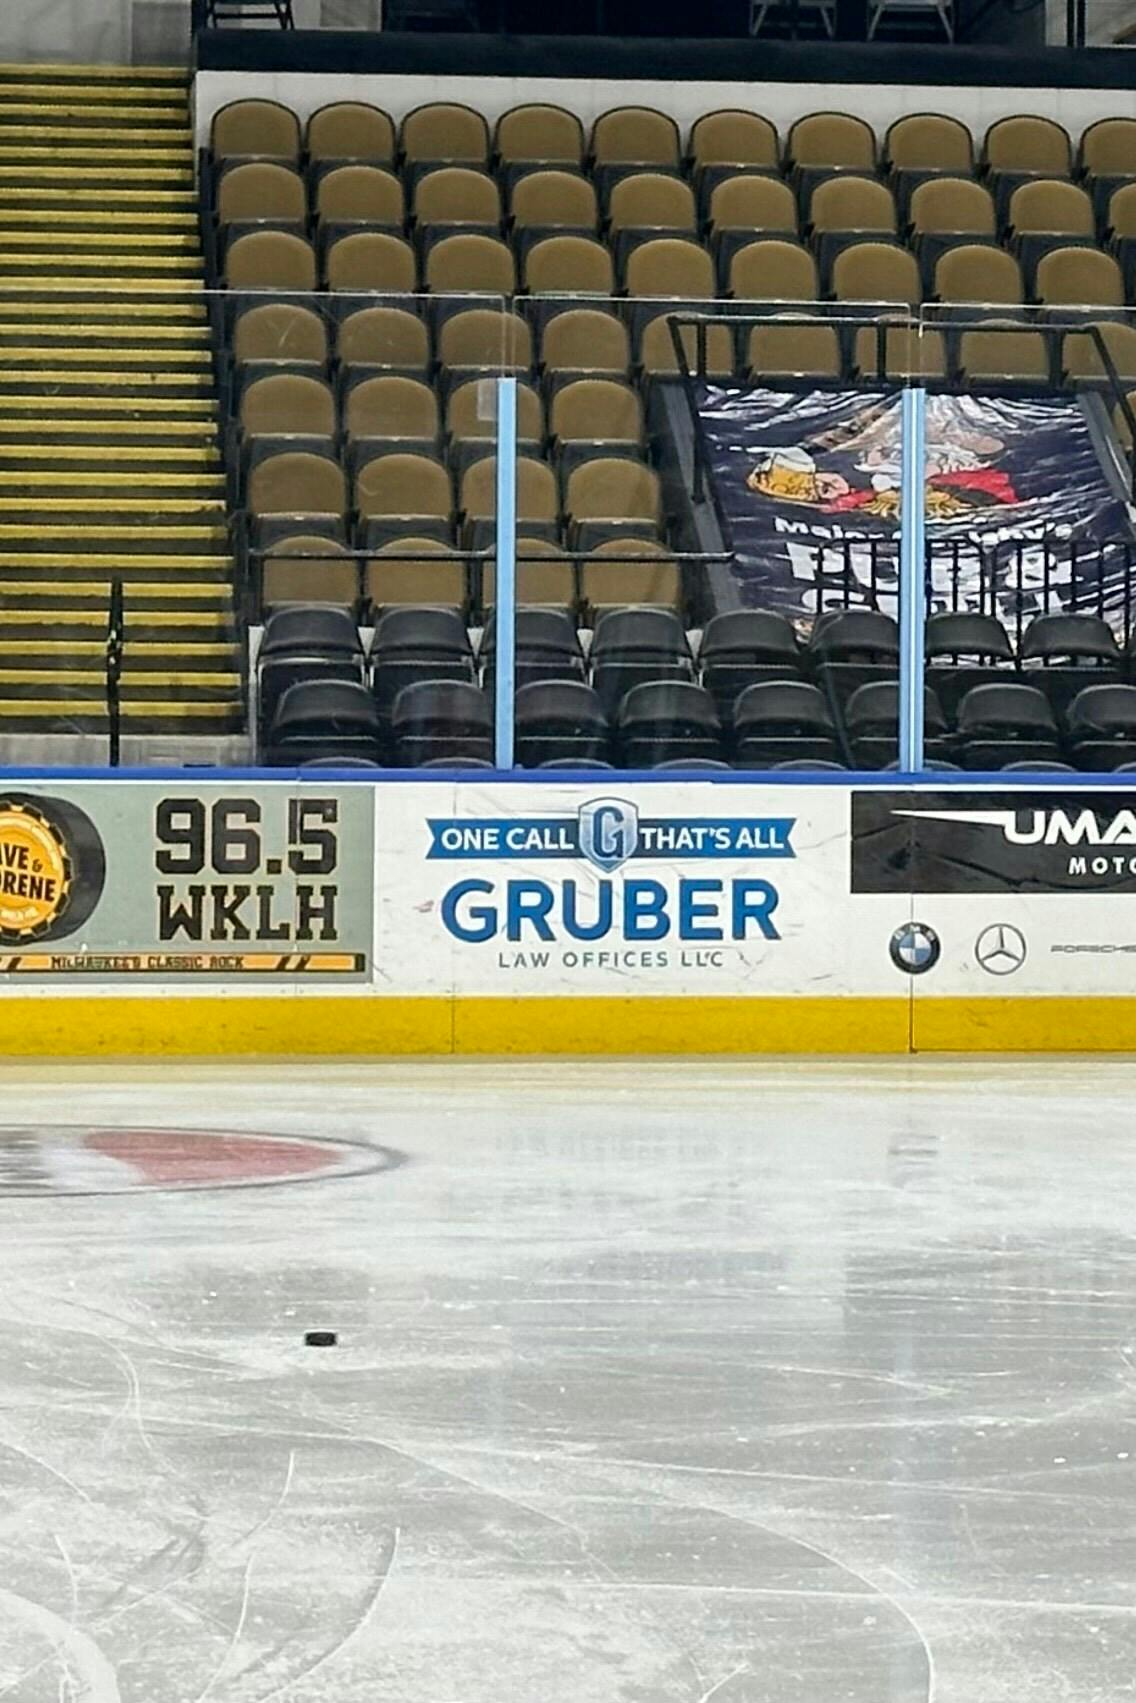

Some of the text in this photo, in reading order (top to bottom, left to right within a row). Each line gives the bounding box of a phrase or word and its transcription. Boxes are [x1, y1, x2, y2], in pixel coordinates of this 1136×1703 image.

[155, 798, 338, 875] 96.5
[441, 829, 574, 850] ONE CALL
[640, 827, 784, 850] THAT'S ALL
[0, 842, 29, 871] VE
[0, 870, 56, 902] RENE
[156, 885, 338, 941] WKLH
[440, 878, 782, 943] GRUBER
[499, 951, 723, 968] LAW OFFICES LLC
[1051, 944, 1136, 953] PORSCHE
[147, 956, 201, 970] CLASSIC
[209, 956, 244, 970] ROCK
